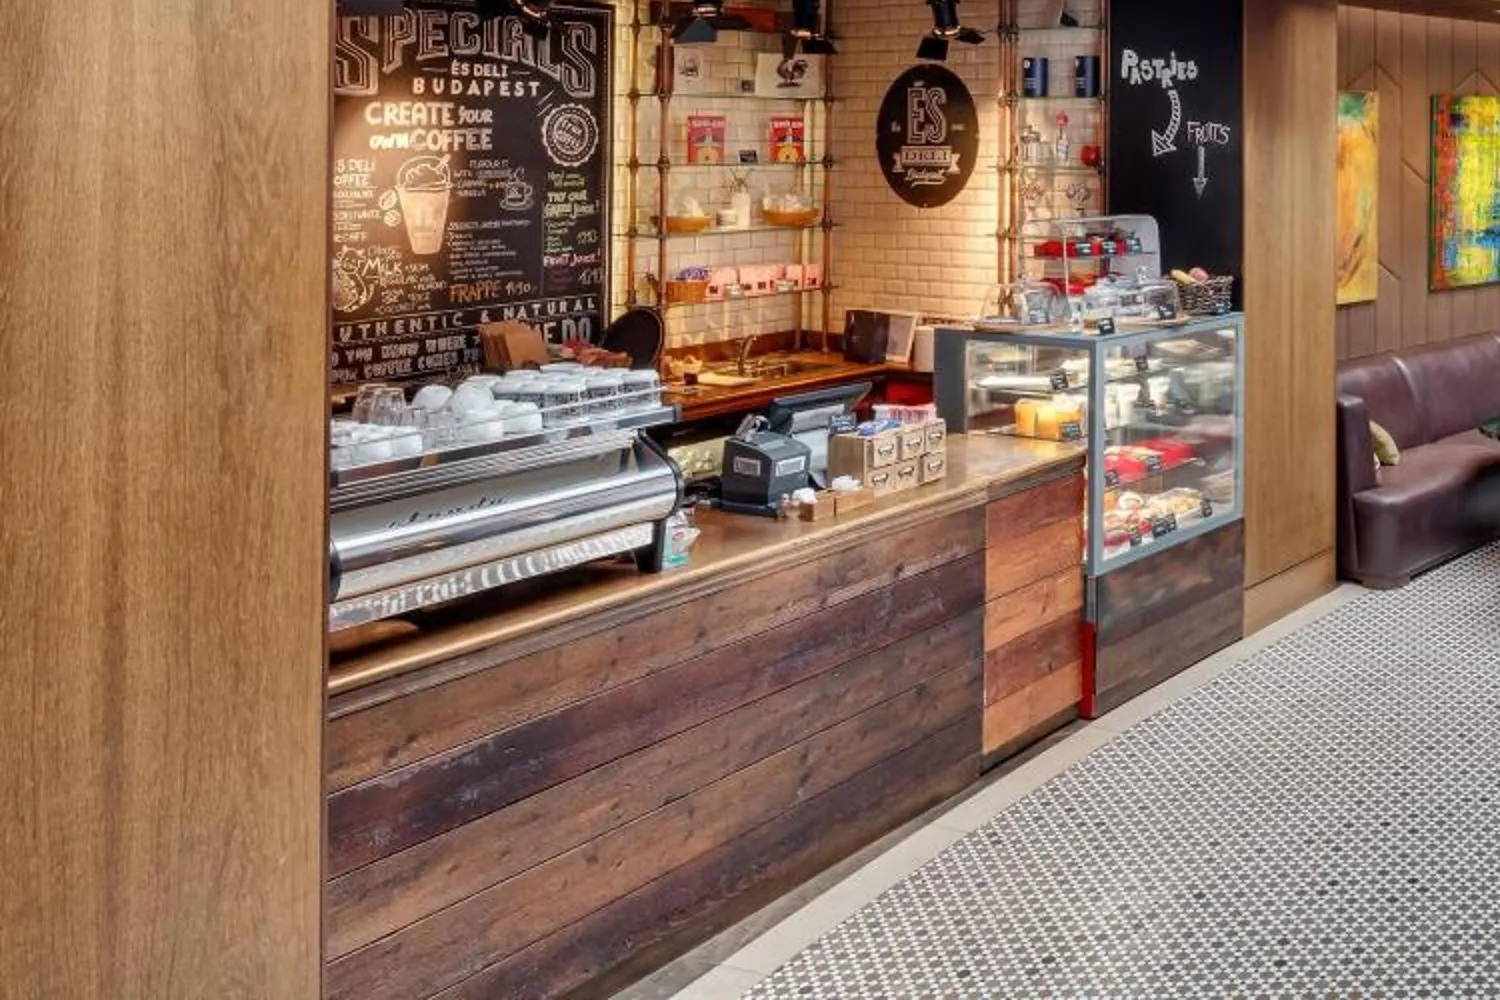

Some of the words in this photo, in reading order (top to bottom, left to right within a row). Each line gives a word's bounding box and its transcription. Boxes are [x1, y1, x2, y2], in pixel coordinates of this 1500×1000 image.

[333, 7, 597, 98] SPECIALS
[451, 60, 470, 76] ÉS
[473, 63, 508, 77] DELI
[413, 77, 540, 98] BUDAPEST
[364, 101, 455, 126] CREATE
[907, 81, 947, 144] ÉS
[409, 127, 493, 152] COFFEE
[1187, 121, 1231, 146] FRUITS
[339, 311, 463, 342] UTHENTIC
[503, 297, 596, 319] NATURAL
